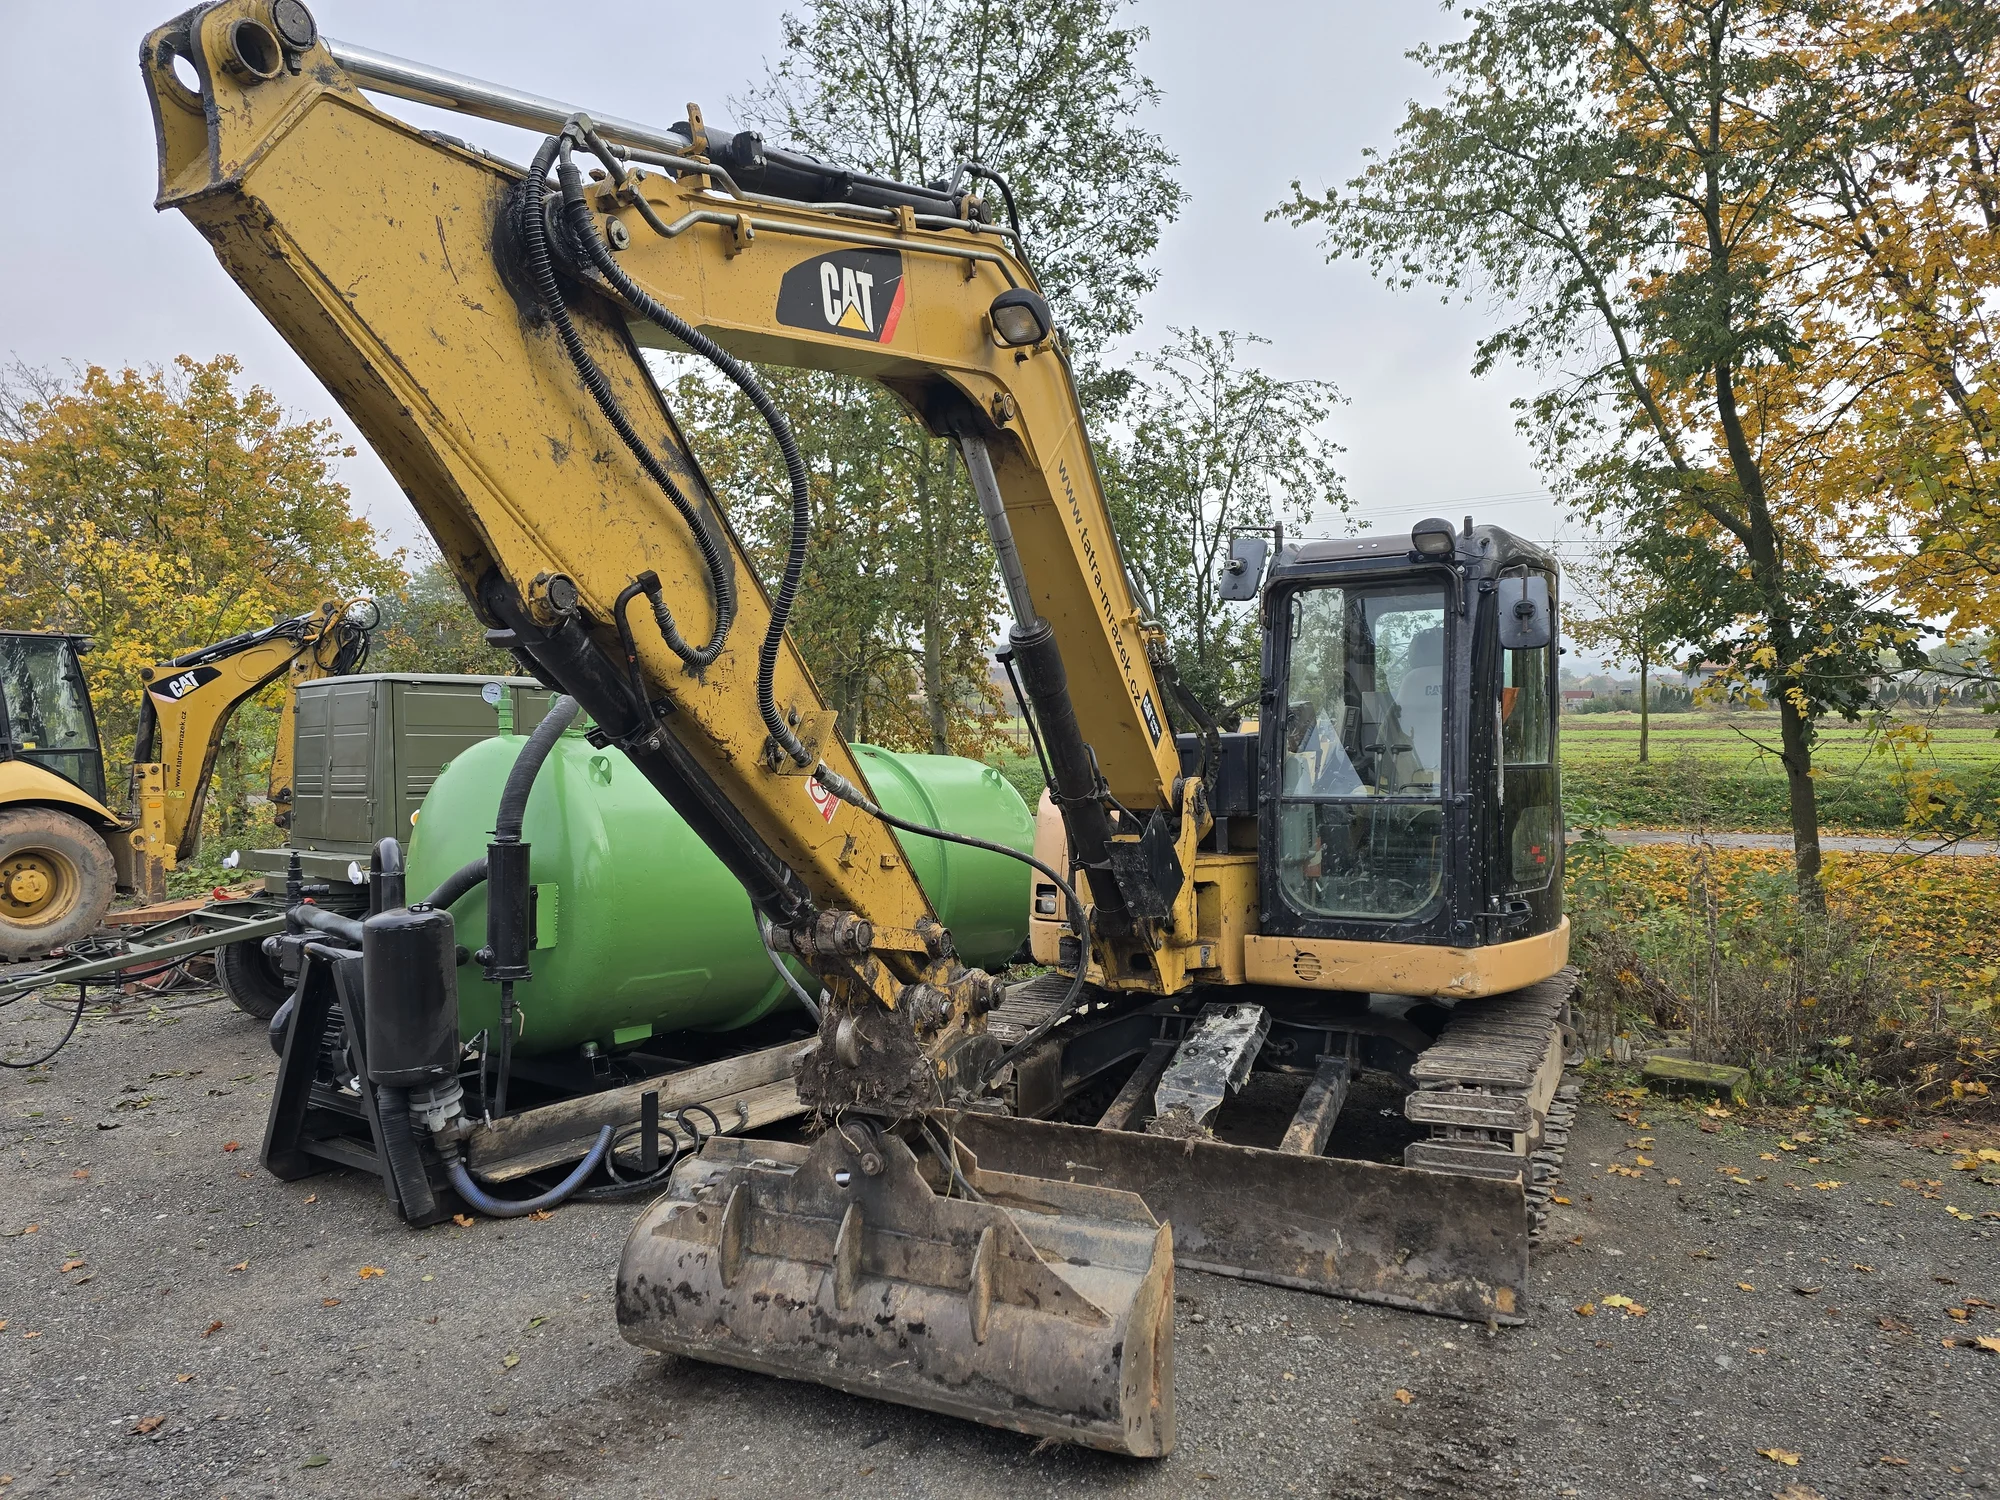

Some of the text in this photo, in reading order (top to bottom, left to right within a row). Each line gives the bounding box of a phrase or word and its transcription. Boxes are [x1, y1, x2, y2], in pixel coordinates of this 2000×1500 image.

[820, 261, 874, 333] CAT
[1059, 458, 1141, 707] www.tatra-mrazek.cz
[169, 670, 200, 698] CAT
[175, 711, 187, 787] www.tatra-mrazek.cz
